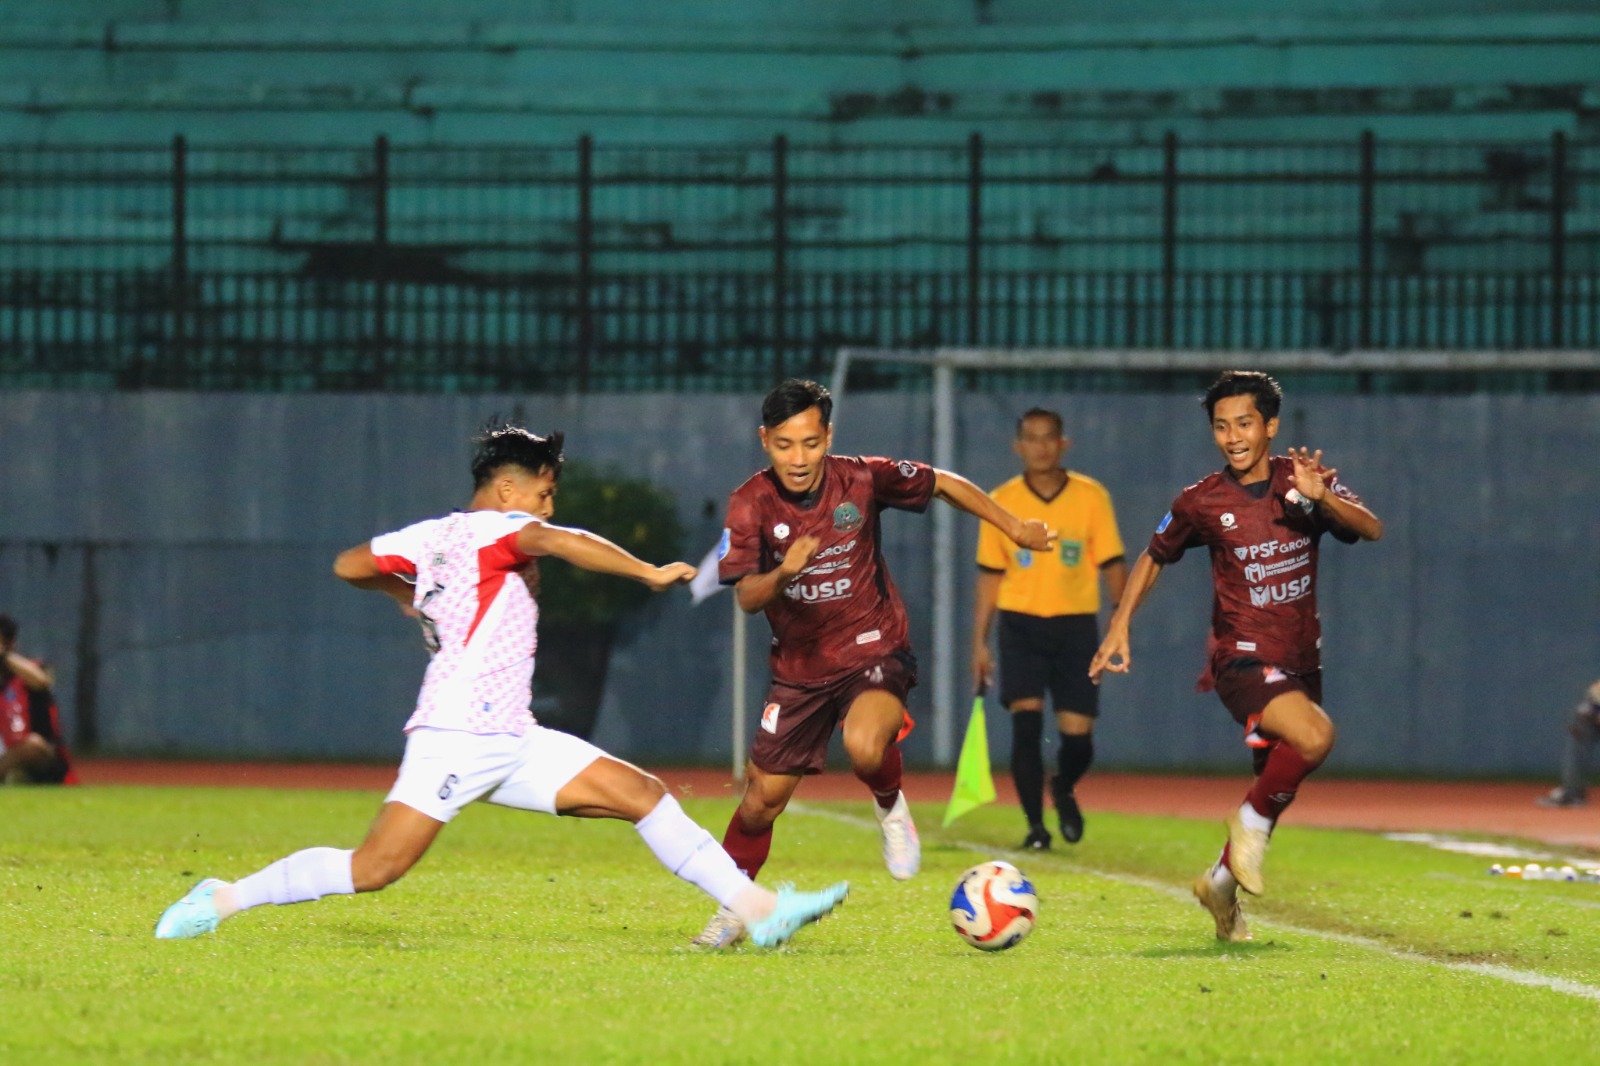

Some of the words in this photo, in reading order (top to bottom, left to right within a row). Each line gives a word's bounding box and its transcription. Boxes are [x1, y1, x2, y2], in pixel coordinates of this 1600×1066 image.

[1249, 540, 1279, 560] PSF
[1279, 536, 1311, 554] GROU
[800, 578, 852, 601] USP
[1270, 574, 1311, 601] USP
[438, 773, 459, 801] 6
